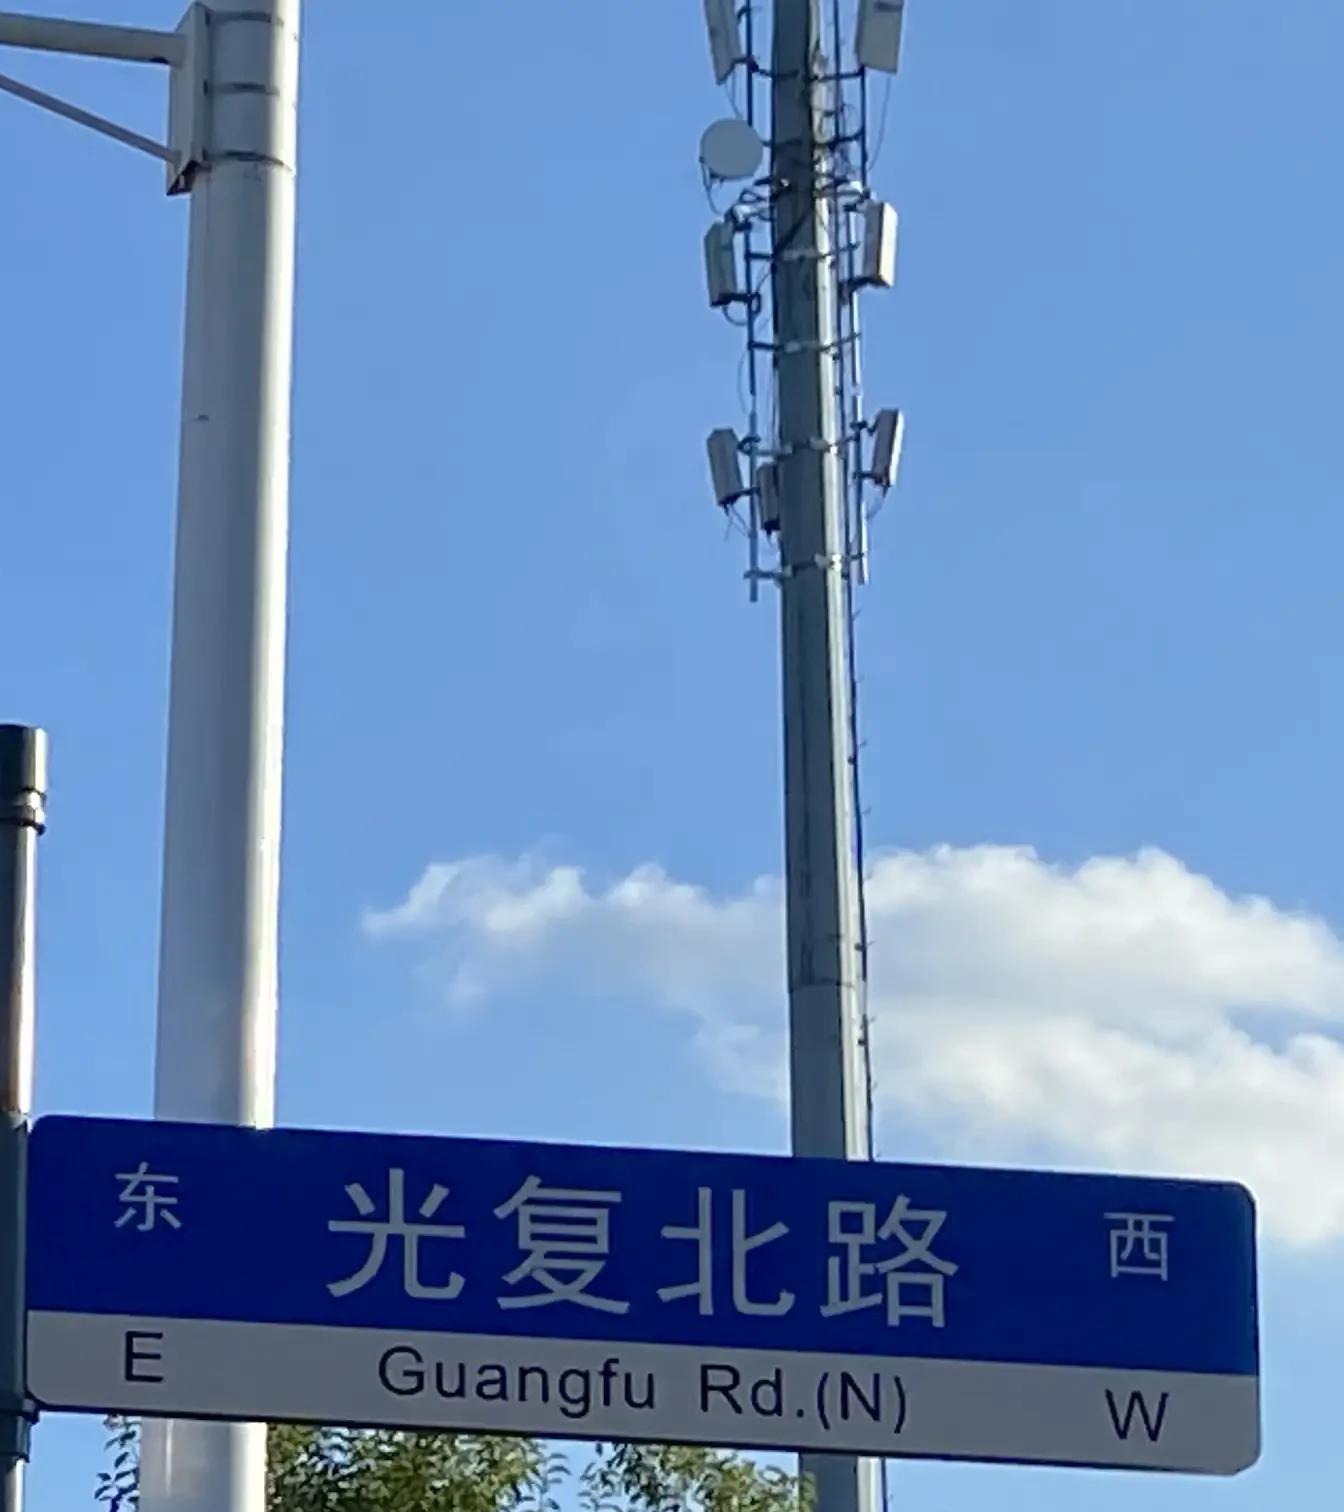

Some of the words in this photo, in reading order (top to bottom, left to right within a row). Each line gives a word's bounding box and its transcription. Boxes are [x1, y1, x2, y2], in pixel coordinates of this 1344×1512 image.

[114, 1162, 182, 1232] 东
[326, 1168, 959, 1327] 光复北路
[1103, 1211, 1175, 1281] 西
[125, 1331, 164, 1383] E
[378, 1345, 655, 1417] Guangfu
[700, 1364, 908, 1433] Rd.(N)
[1105, 1388, 1170, 1443] W
